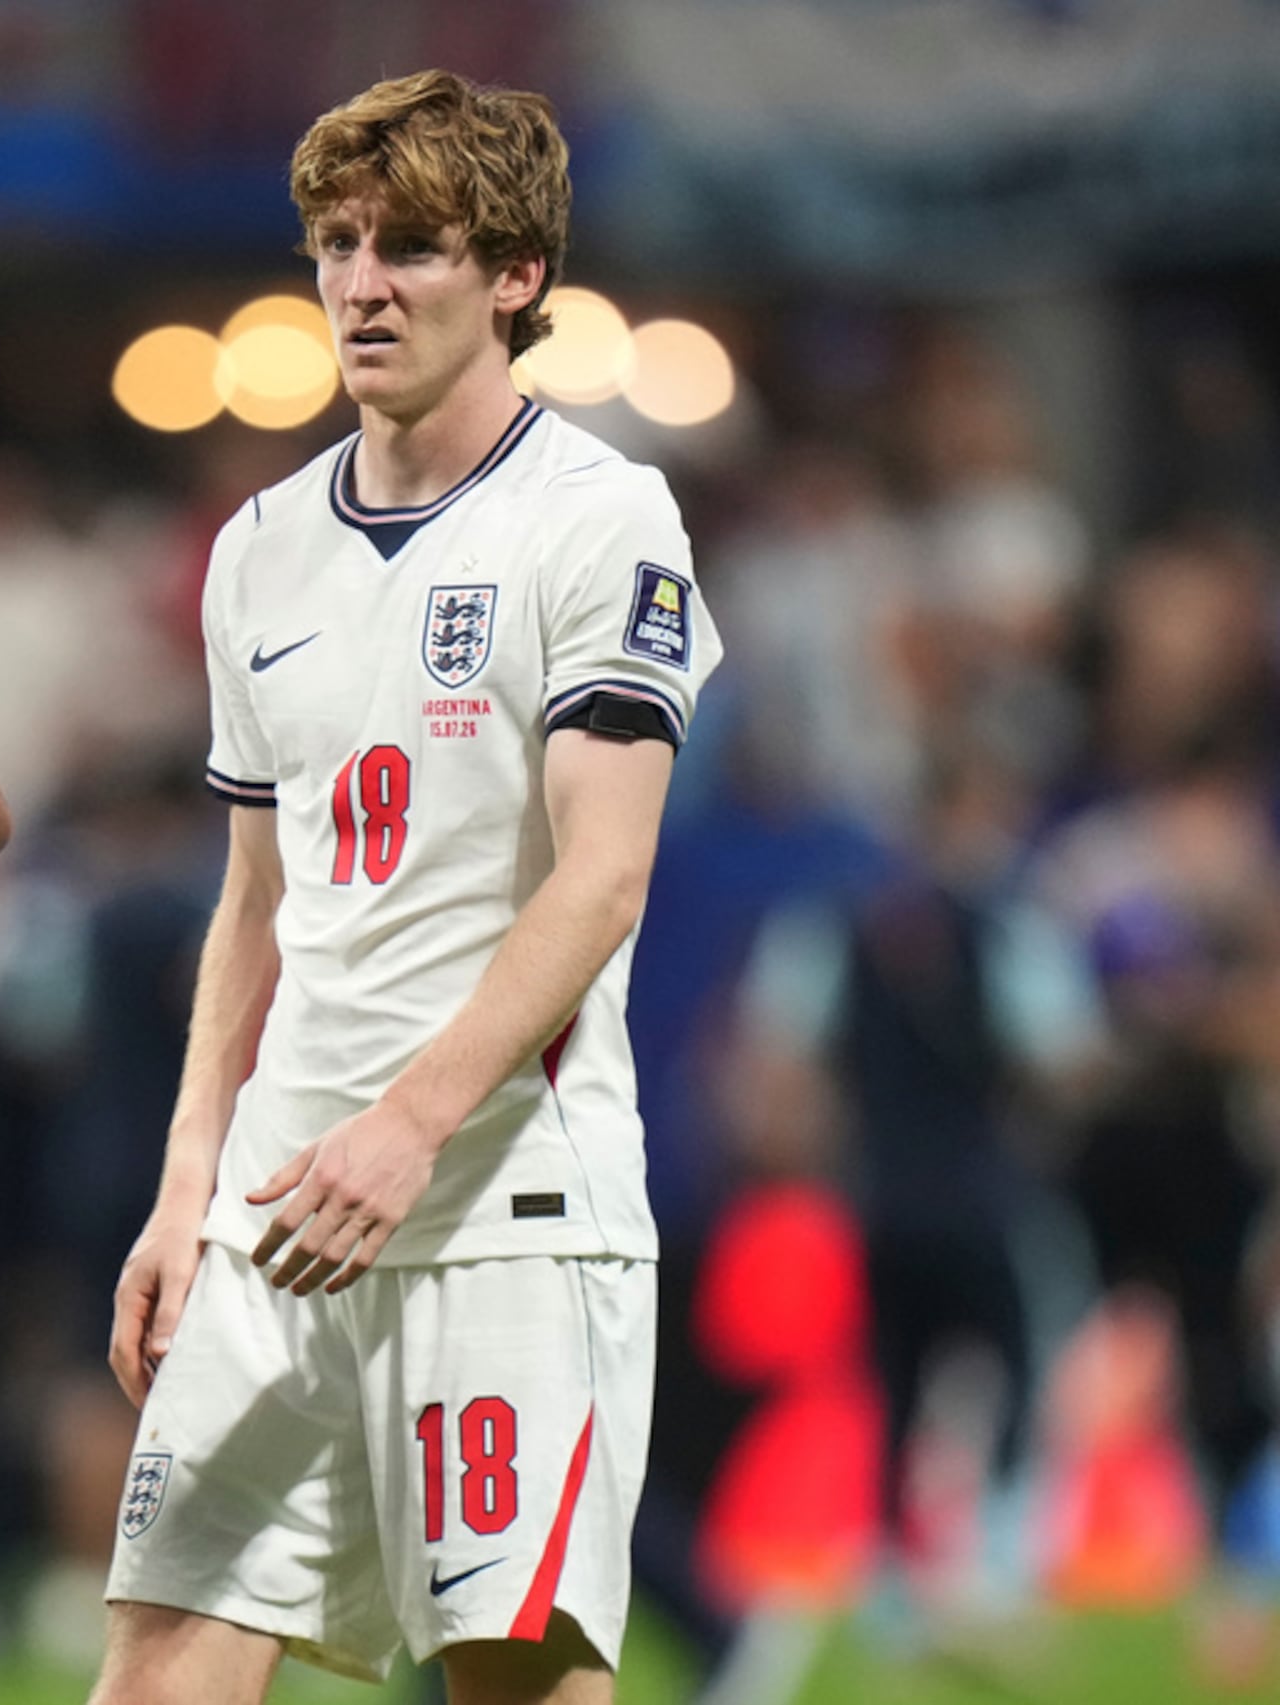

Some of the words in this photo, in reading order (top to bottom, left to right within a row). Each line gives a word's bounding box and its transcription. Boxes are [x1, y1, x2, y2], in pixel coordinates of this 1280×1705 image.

[430, 720, 477, 738] 15.07.26
[331, 744, 411, 885] 18
[416, 1396, 519, 1543] 18
